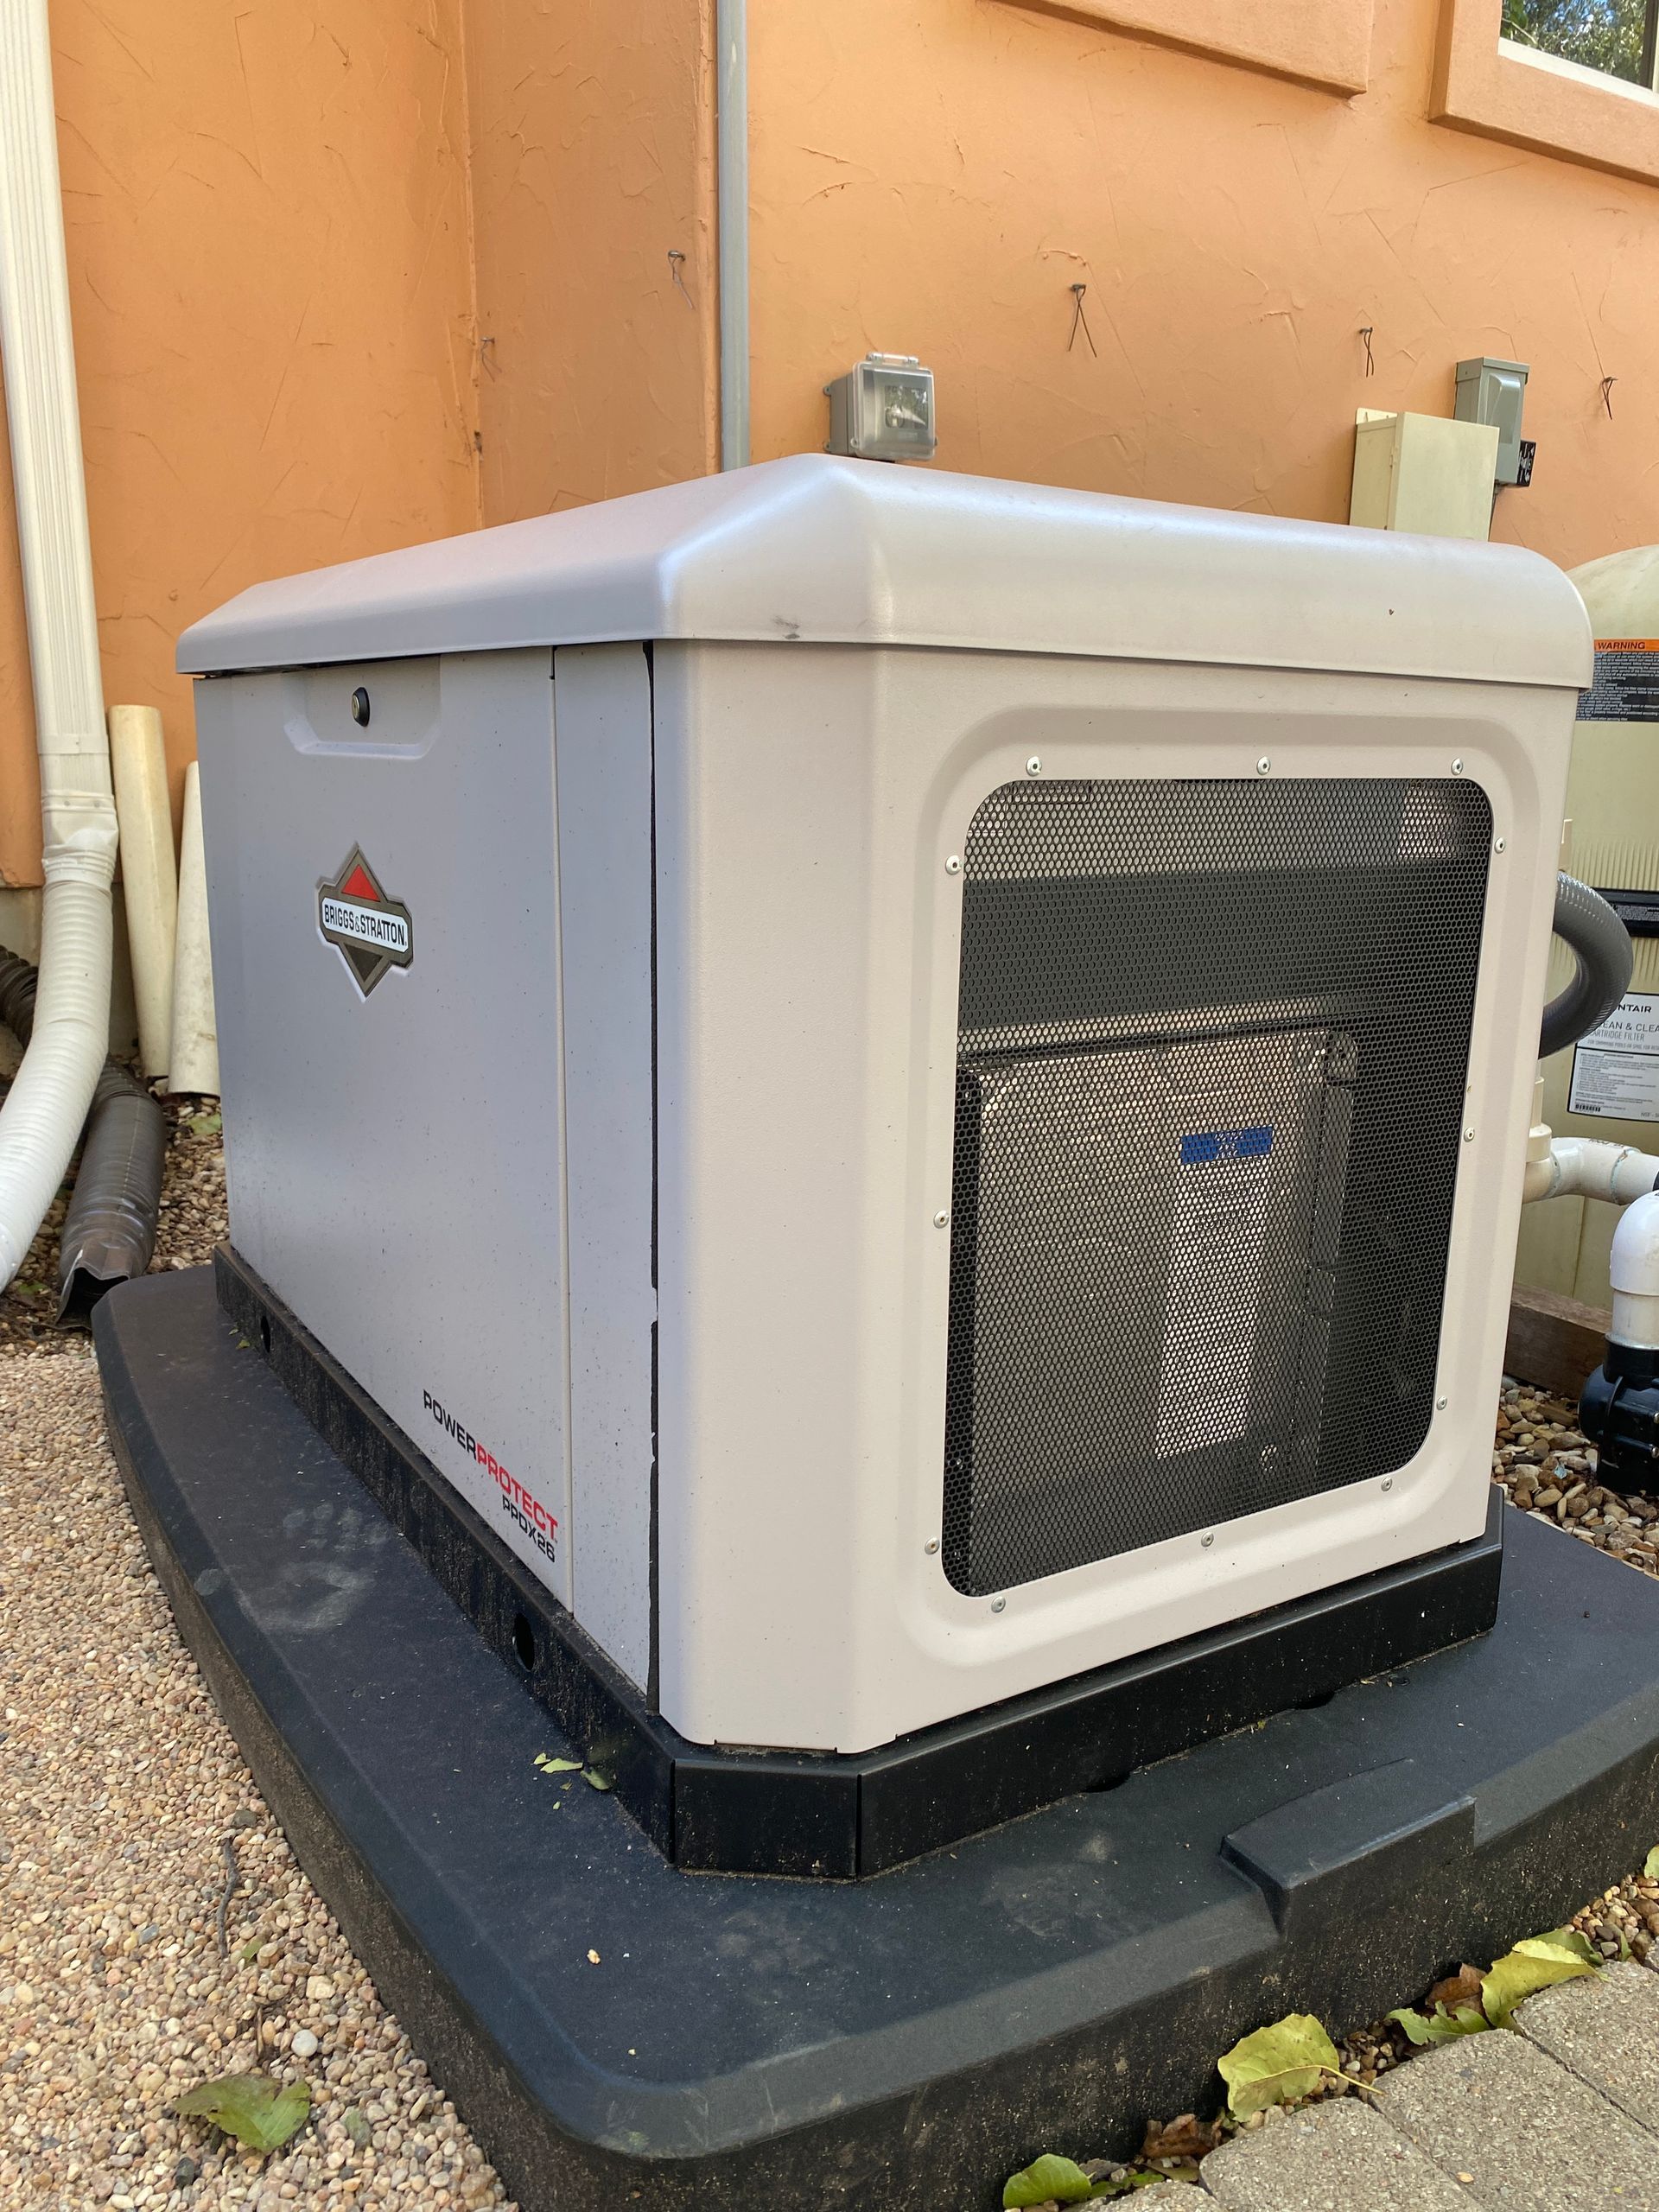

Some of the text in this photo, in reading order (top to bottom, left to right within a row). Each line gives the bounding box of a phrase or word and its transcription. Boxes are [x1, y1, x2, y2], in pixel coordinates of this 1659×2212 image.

[1598, 641, 1646, 650] WARNING
[1618, 1003, 1652, 1014] NTAIR
[1625, 1022, 1633, 1032] &
[1591, 1028, 1645, 1042] ARTRIDGE FILTER
[502, 1494, 556, 1563] PPDX26
